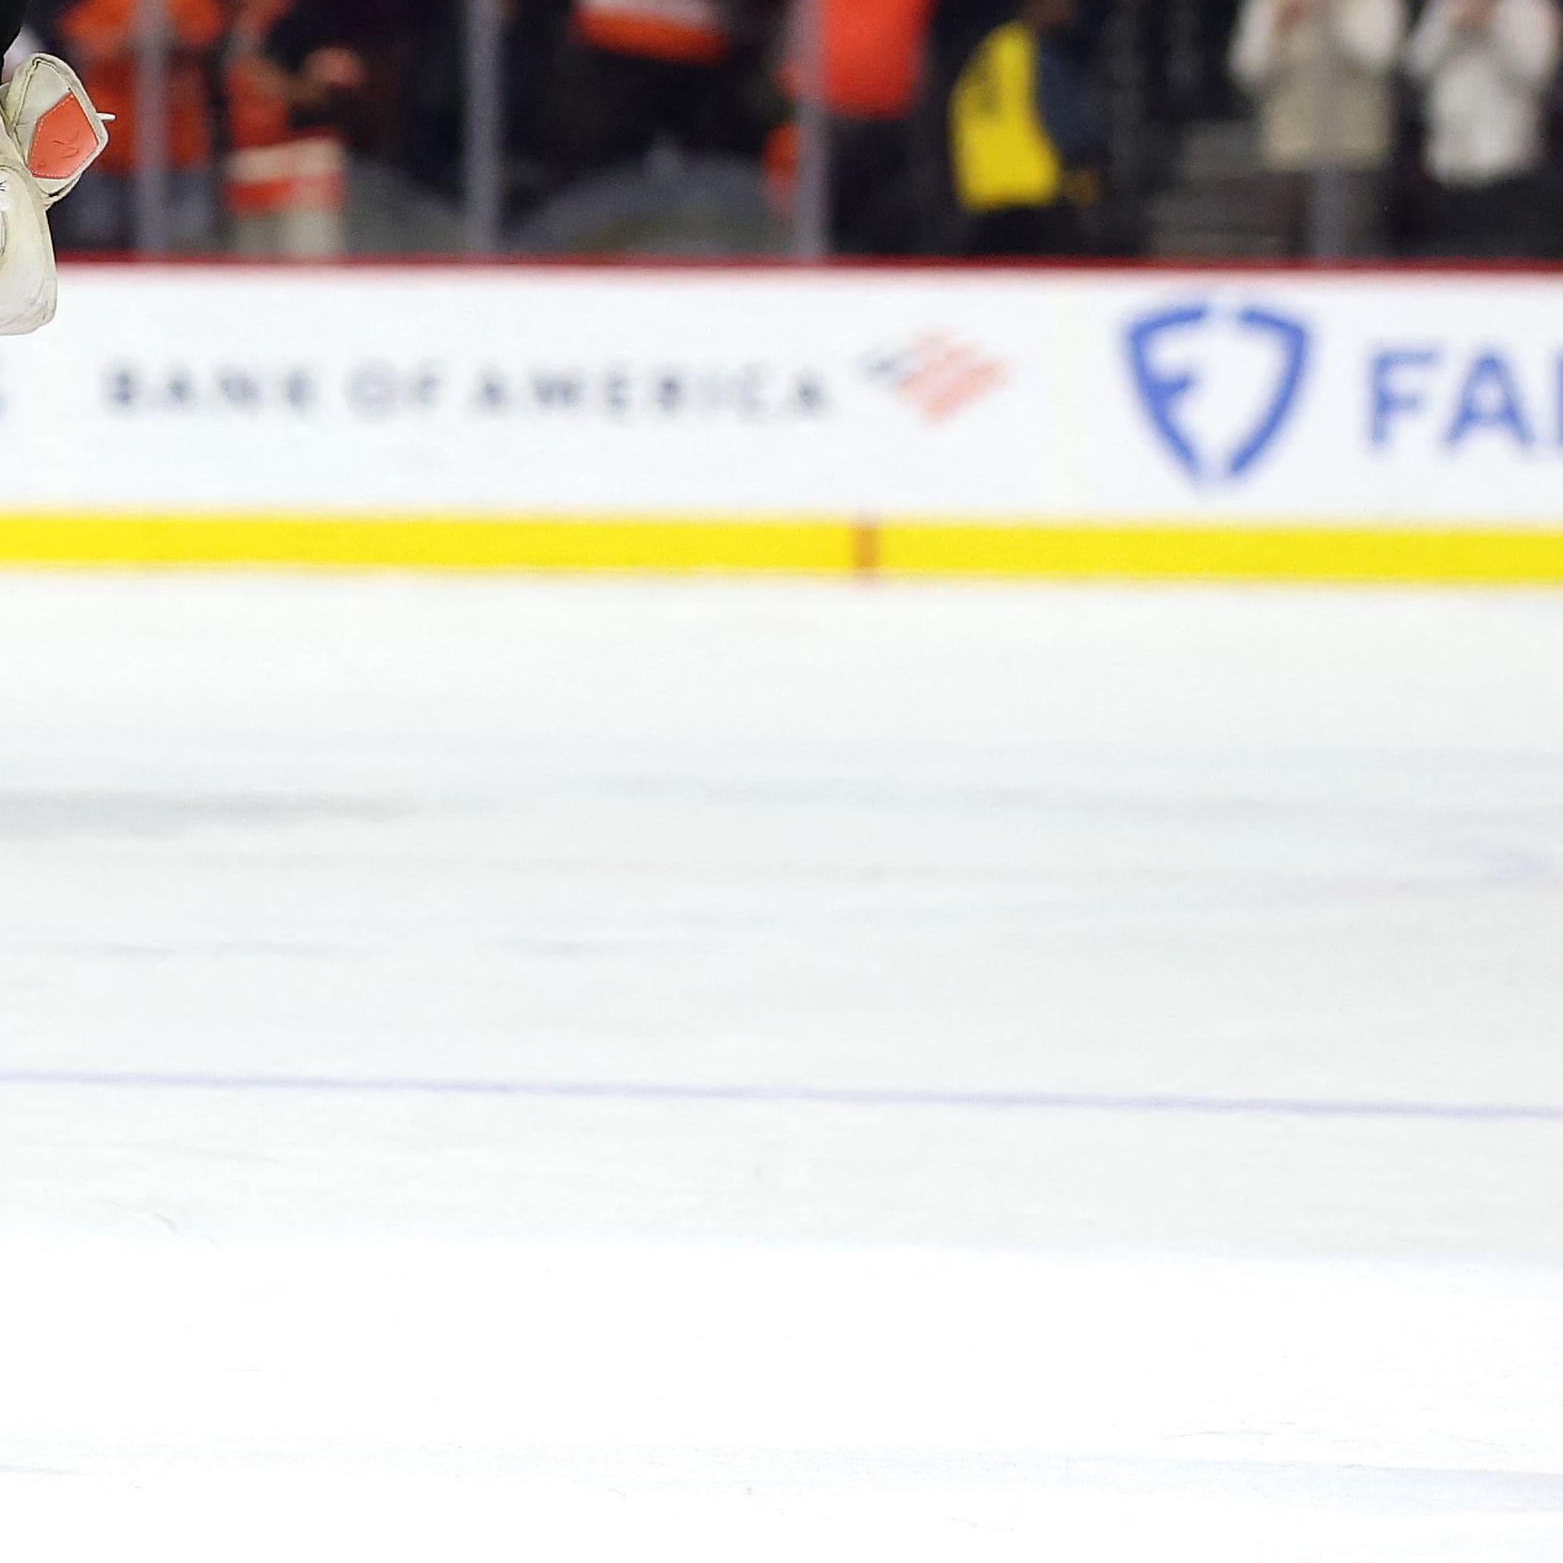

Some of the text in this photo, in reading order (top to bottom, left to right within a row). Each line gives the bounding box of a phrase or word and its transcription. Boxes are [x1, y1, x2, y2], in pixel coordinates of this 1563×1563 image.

[104, 360, 831, 420] BANK OF AMERICA
[1367, 346, 1563, 448] FA
